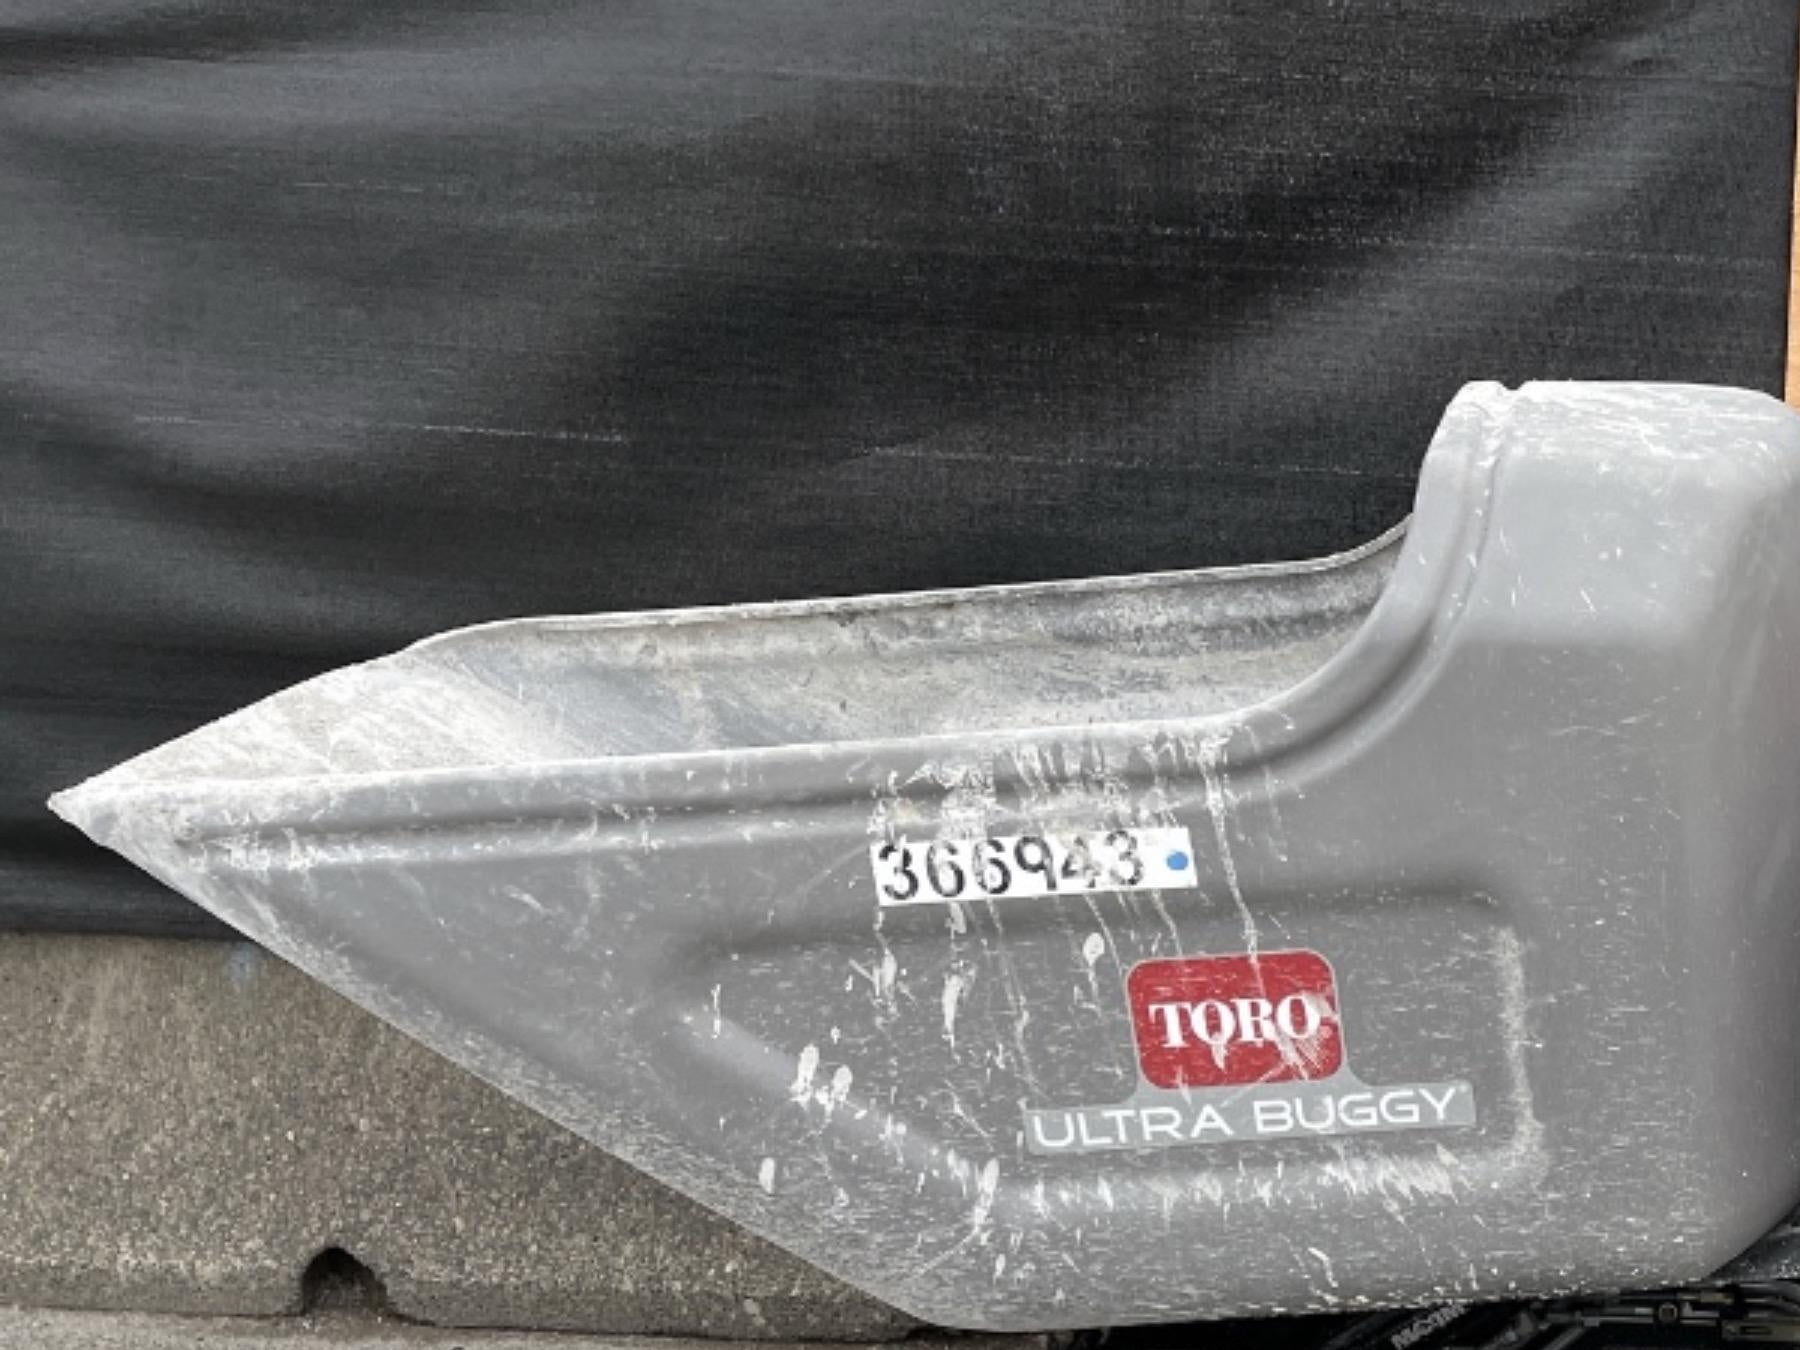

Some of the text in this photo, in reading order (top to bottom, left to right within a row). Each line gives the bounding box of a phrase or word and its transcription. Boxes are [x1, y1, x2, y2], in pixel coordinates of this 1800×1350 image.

[878, 829, 1143, 900] 366943
[1148, 994, 1322, 1049] TORO
[1033, 1086, 1458, 1148] ULTRA BUGGY
